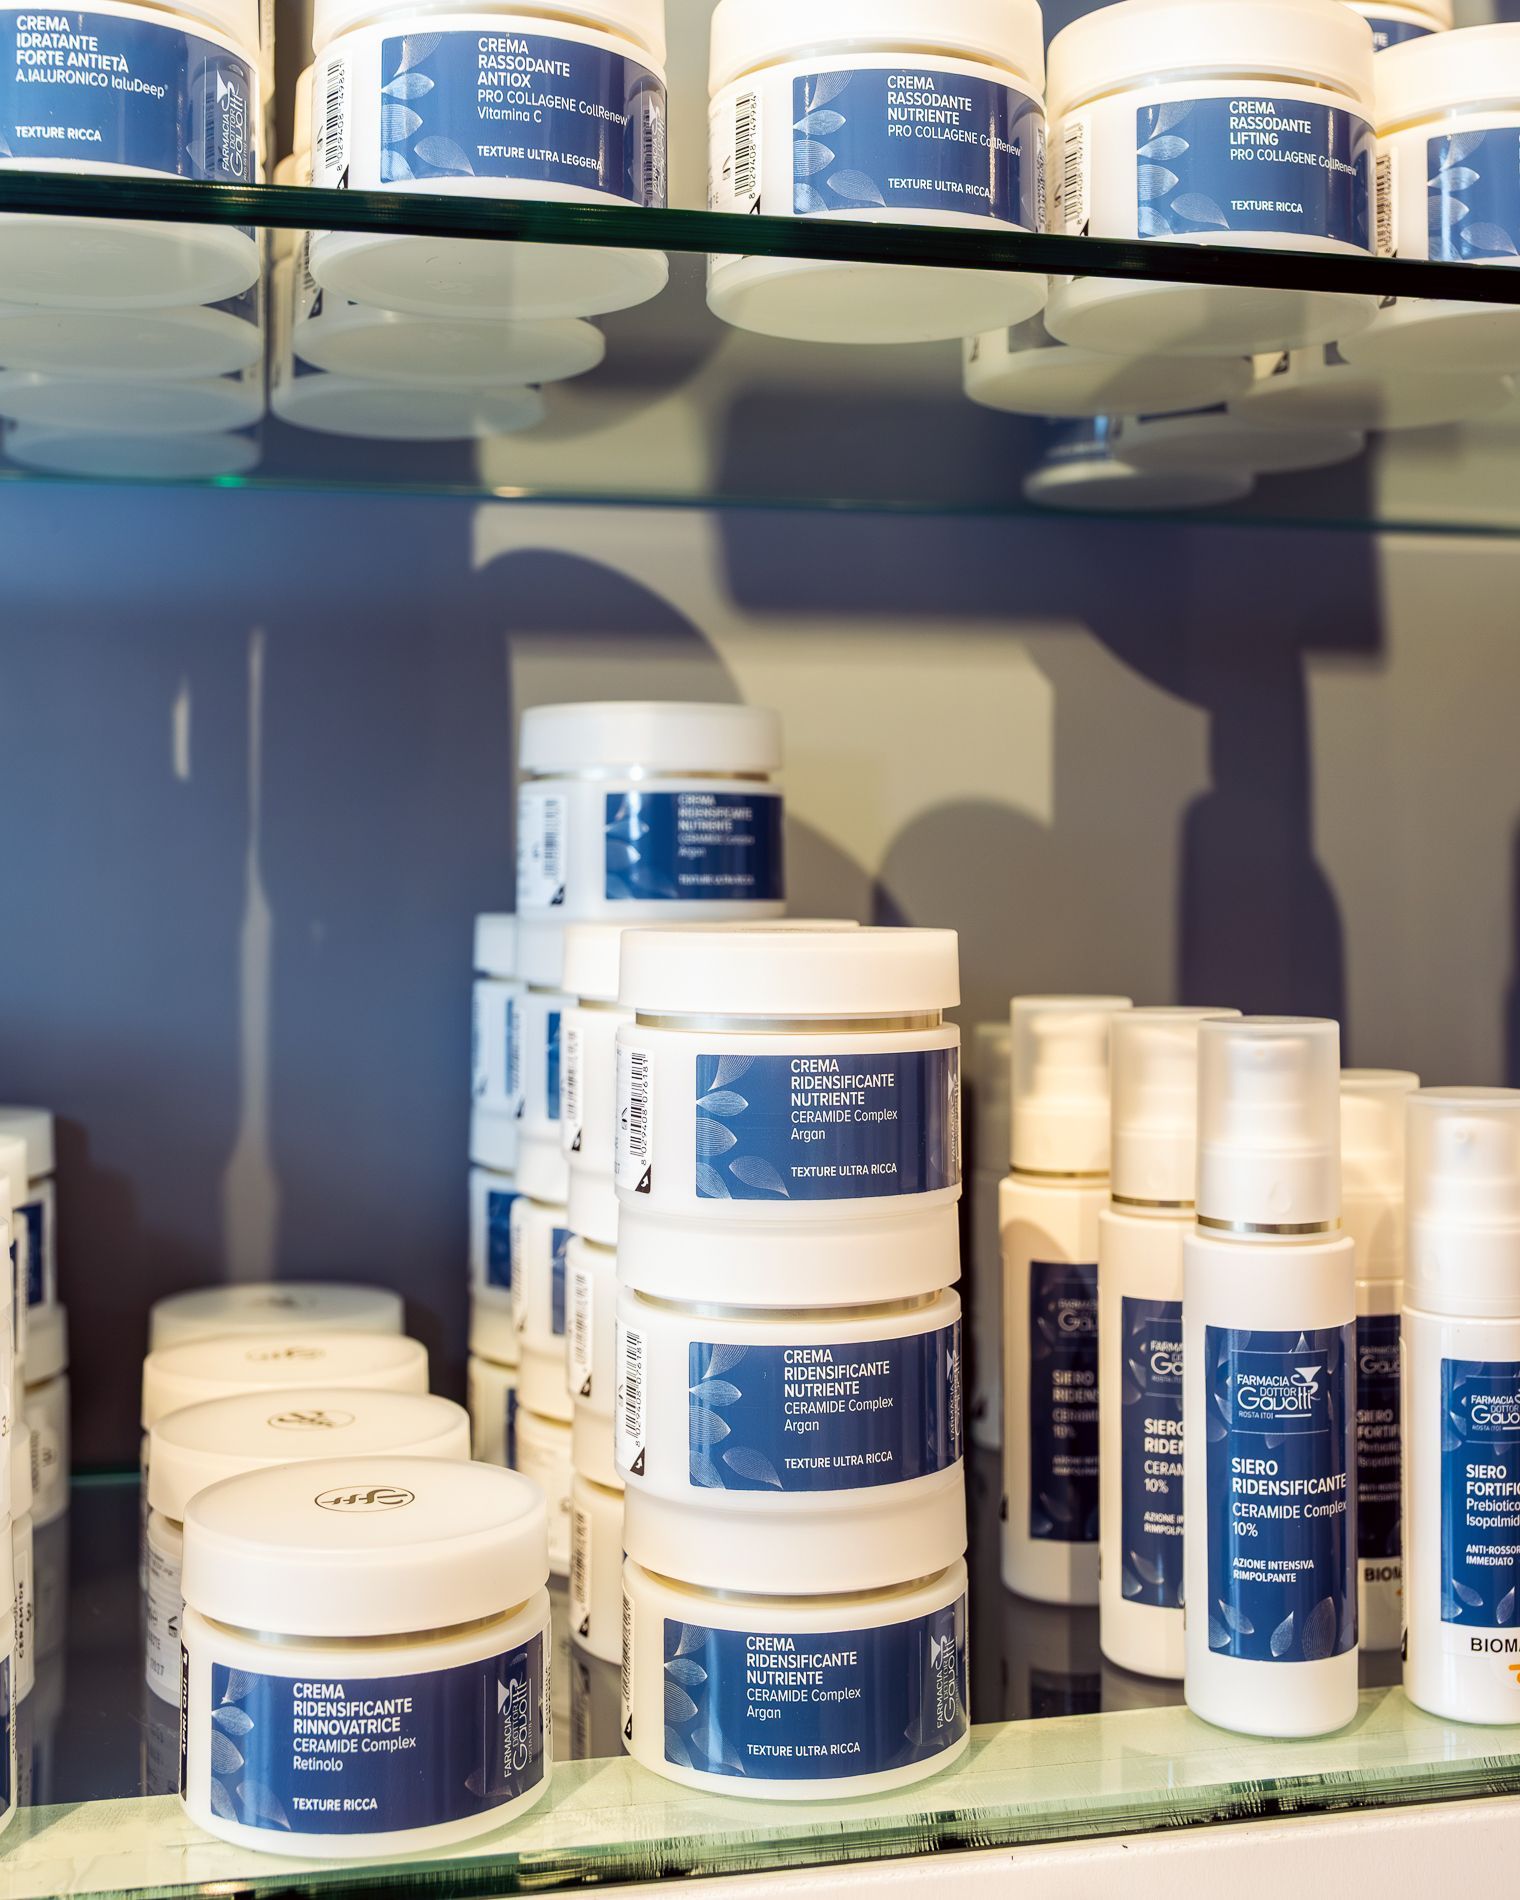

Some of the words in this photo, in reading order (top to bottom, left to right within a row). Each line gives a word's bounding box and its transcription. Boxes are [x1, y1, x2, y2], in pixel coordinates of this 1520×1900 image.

[17, 15, 70, 32] CREMA
[16, 33, 98, 52] IDRATANTE
[478, 37, 529, 55] CREMA
[16, 49, 63, 67] FORTE
[67, 53, 129, 73] ANTIETÀ
[478, 55, 570, 78] RASSODANTE
[15, 68, 108, 88] A.IALURONICO
[477, 72, 531, 89] ANTIOX
[887, 75, 935, 91] CREMA
[478, 89, 504, 104] PRO
[506, 90, 577, 112] COLLAGENE
[887, 92, 972, 112] RASSODANTE
[1229, 100, 1276, 115] CREMA
[477, 106, 530, 122] Vitamina
[532, 110, 542, 124] C
[888, 108, 960, 125] NUTRIENTE
[15, 126, 65, 140] TEXTURE
[67, 127, 102, 142] RICCA
[888, 124, 912, 138] PRO
[915, 125, 978, 145] COLLAGENE
[1230, 117, 1311, 135] RASSODANTE
[1230, 132, 1279, 146] LIFTING
[477, 145, 525, 160] TEXTURE
[527, 147, 559, 163] ULTRA
[561, 153, 603, 171] LEGGERA
[749, 144, 757, 188] 029408
[1230, 148, 1254, 162] PRO
[1257, 150, 1317, 167] COLLAGENE
[888, 178, 933, 191] TEXTURE
[934, 180, 964, 194] ULTRA
[965, 183, 991, 198] RICCA
[1231, 200, 1274, 213] TEXTURE
[1275, 202, 1304, 214] RICCA
[791, 1059, 839, 1073] CREMA
[791, 1073, 894, 1090] RIDENSIFICANTE
[791, 1092, 865, 1107] NUTRIENTE
[791, 1109, 851, 1123] CERAMIDE
[854, 1109, 898, 1124] Complex
[791, 1128, 825, 1143] Argan
[791, 1165, 836, 1178] TEXTURE
[839, 1164, 869, 1176] ULTRA
[871, 1163, 897, 1175] RICCA
[784, 1349, 833, 1364] CREMA
[784, 1361, 890, 1381] RIDENSIFICANTE
[1237, 1374, 1290, 1386] FARMACIA
[784, 1381, 860, 1398] NUTRIENTE
[1260, 1387, 1297, 1397] DOTTOR
[784, 1401, 846, 1415] CERAMIDE
[848, 1396, 894, 1413] Complex
[1238, 1387, 1312, 1410] Gavotti
[1471, 1395, 1514, 1405] FARMACIA
[784, 1419, 820, 1433] Argan
[785, 1456, 831, 1469] TEXTURE
[833, 1454, 864, 1467] ULTRA
[865, 1451, 893, 1464] RICCA
[1232, 1458, 1278, 1476] SIERO
[1466, 1464, 1507, 1479] SIERO
[1144, 1478, 1169, 1494] 10%
[1232, 1473, 1347, 1495] RIDENSIFICANTE
[1232, 1502, 1300, 1519] CERAMIDE
[1304, 1500, 1347, 1518] Complex
[1233, 1522, 1258, 1537] 10%
[1233, 1558, 1266, 1570] AZIONE
[1268, 1559, 1314, 1570] INTENSIVA
[1466, 1556, 1514, 1566] IMMEDIATO
[1233, 1570, 1296, 1583] RIMPOLPANTE
[747, 1637, 795, 1651] CREMA
[1471, 1638, 1520, 1653] BIOM
[747, 1652, 857, 1669] RIDENSIFICANTE
[747, 1671, 823, 1685] NUTRIENTE
[293, 1683, 344, 1699] CREMA
[747, 1688, 808, 1702] CERAMIDE
[811, 1687, 861, 1703] Complex
[293, 1698, 412, 1717] RIDENSIFICANTE
[747, 1705, 781, 1720] Argan
[293, 1717, 401, 1734] RINNOVATRICE
[513, 1681, 527, 1771] Gavotti
[293, 1738, 358, 1753] CERAMIDE
[361, 1736, 416, 1753] Complex
[747, 1744, 792, 1757] TEXTURE
[795, 1744, 828, 1757] ULTRA
[830, 1742, 860, 1754] RICCA
[293, 1756, 343, 1771] Retinolo
[293, 1798, 341, 1811] TEXTURE
[343, 1798, 377, 1810] RICCA
